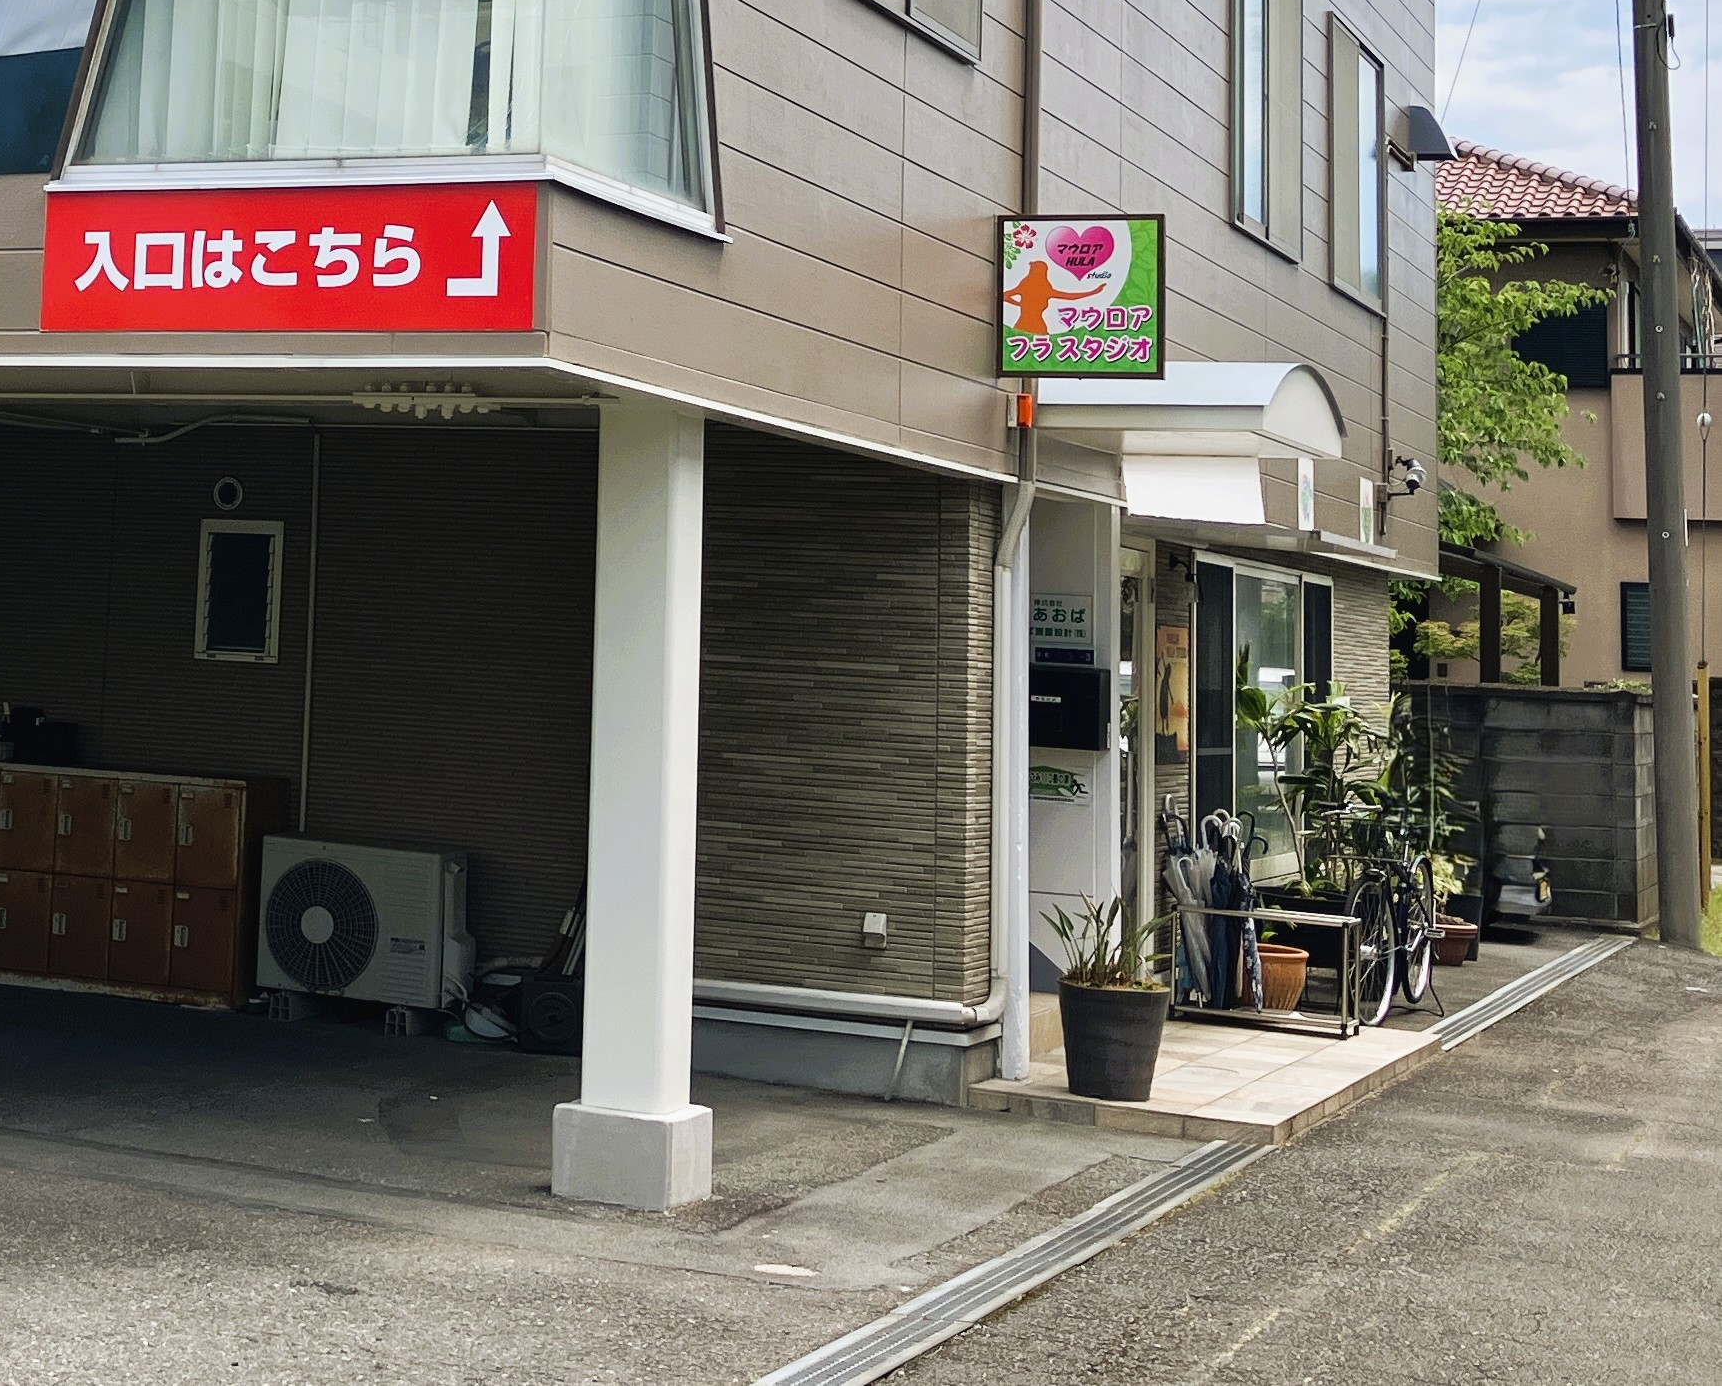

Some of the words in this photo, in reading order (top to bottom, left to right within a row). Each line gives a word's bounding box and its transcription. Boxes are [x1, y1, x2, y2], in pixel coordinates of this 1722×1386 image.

[1056, 244, 1103, 255] マウロア
[75, 224, 421, 292] 入口はこちら
[1066, 256, 1096, 267] HULA
[1086, 271, 1112, 279] studio
[1058, 306, 1151, 330] マウロア
[1033, 608, 1086, 623] あおば
